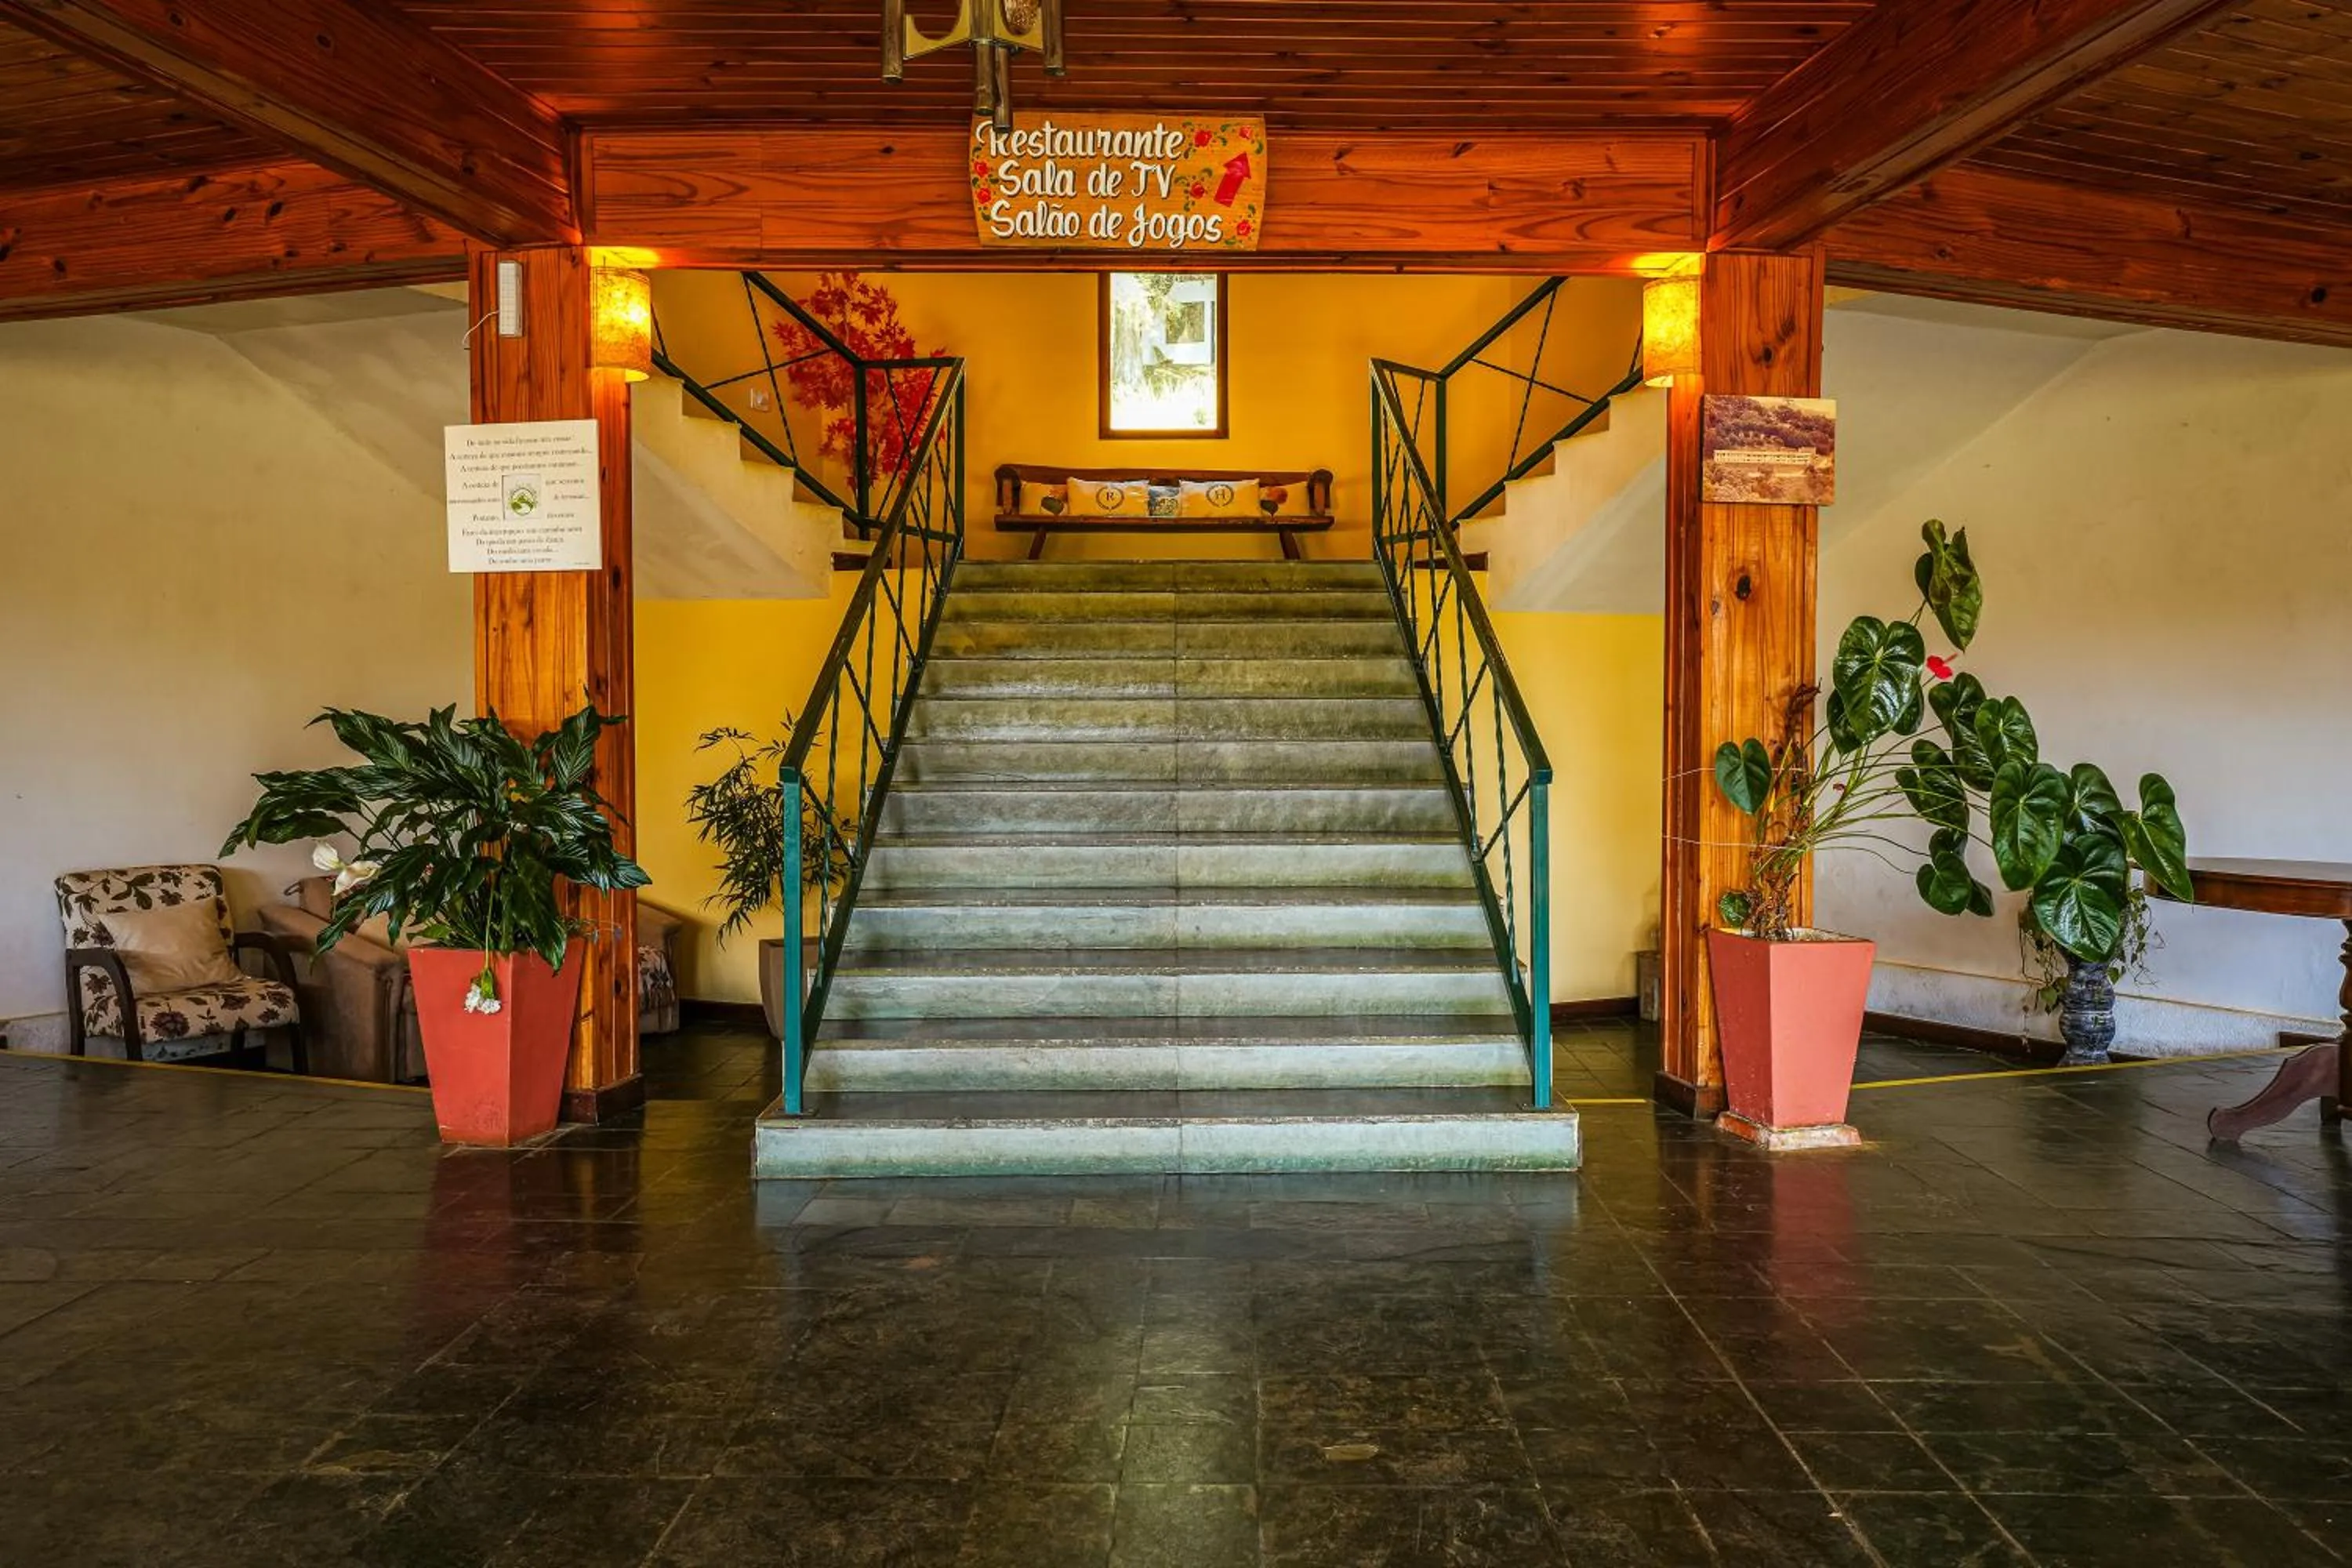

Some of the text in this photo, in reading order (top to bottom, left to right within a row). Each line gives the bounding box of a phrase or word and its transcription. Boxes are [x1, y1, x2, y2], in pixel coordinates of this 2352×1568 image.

[976, 120, 1184, 159] Restaurante
[997, 159, 1176, 198] Sala de TV
[989, 200, 1224, 248] Salão de Jogos
[1215, 490, 1226, 500] H
